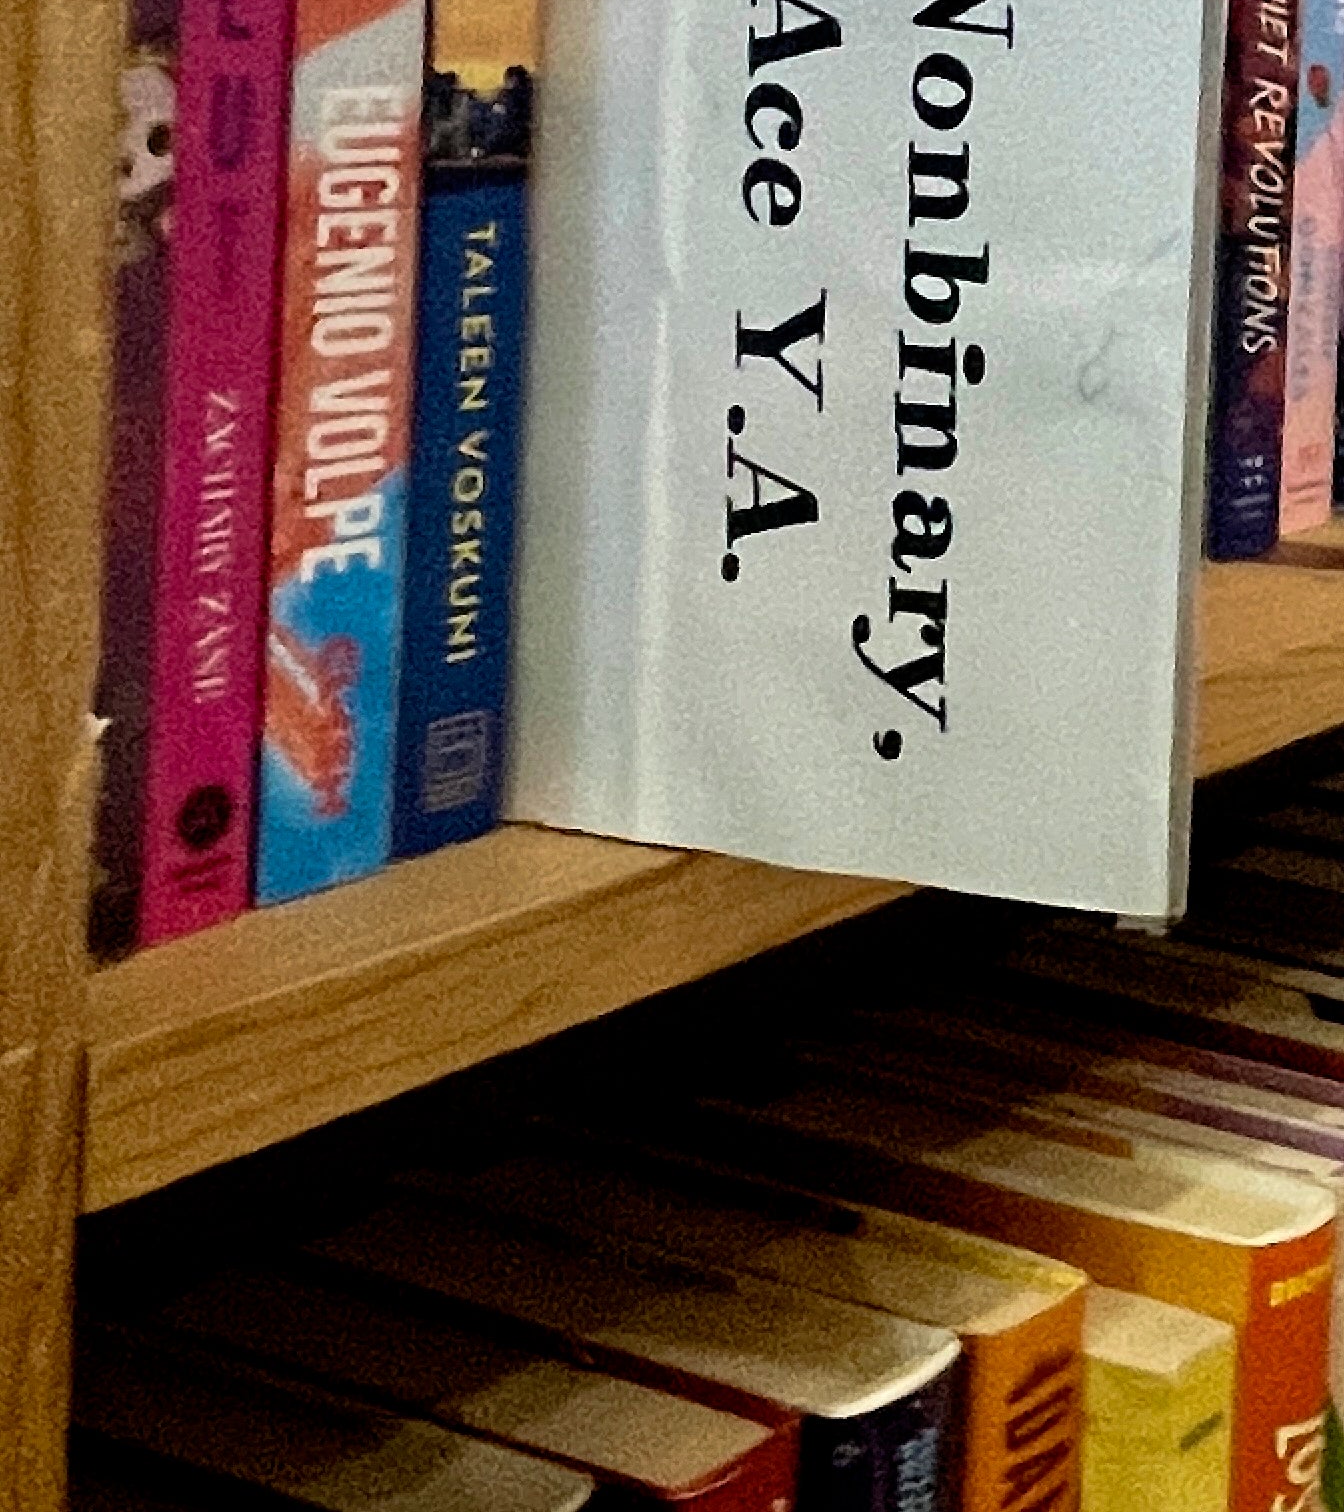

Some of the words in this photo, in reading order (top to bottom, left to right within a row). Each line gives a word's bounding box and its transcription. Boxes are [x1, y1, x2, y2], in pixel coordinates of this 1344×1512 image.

[308, 87, 402, 358] EUGENIO
[456, 221, 498, 412] TALEEN
[1241, 85, 1293, 357] REVOLUTIONS
[299, 368, 392, 582] VOLPE
[444, 429, 488, 664] VOSKUNI
[720, 288, 828, 584] Y.A.
